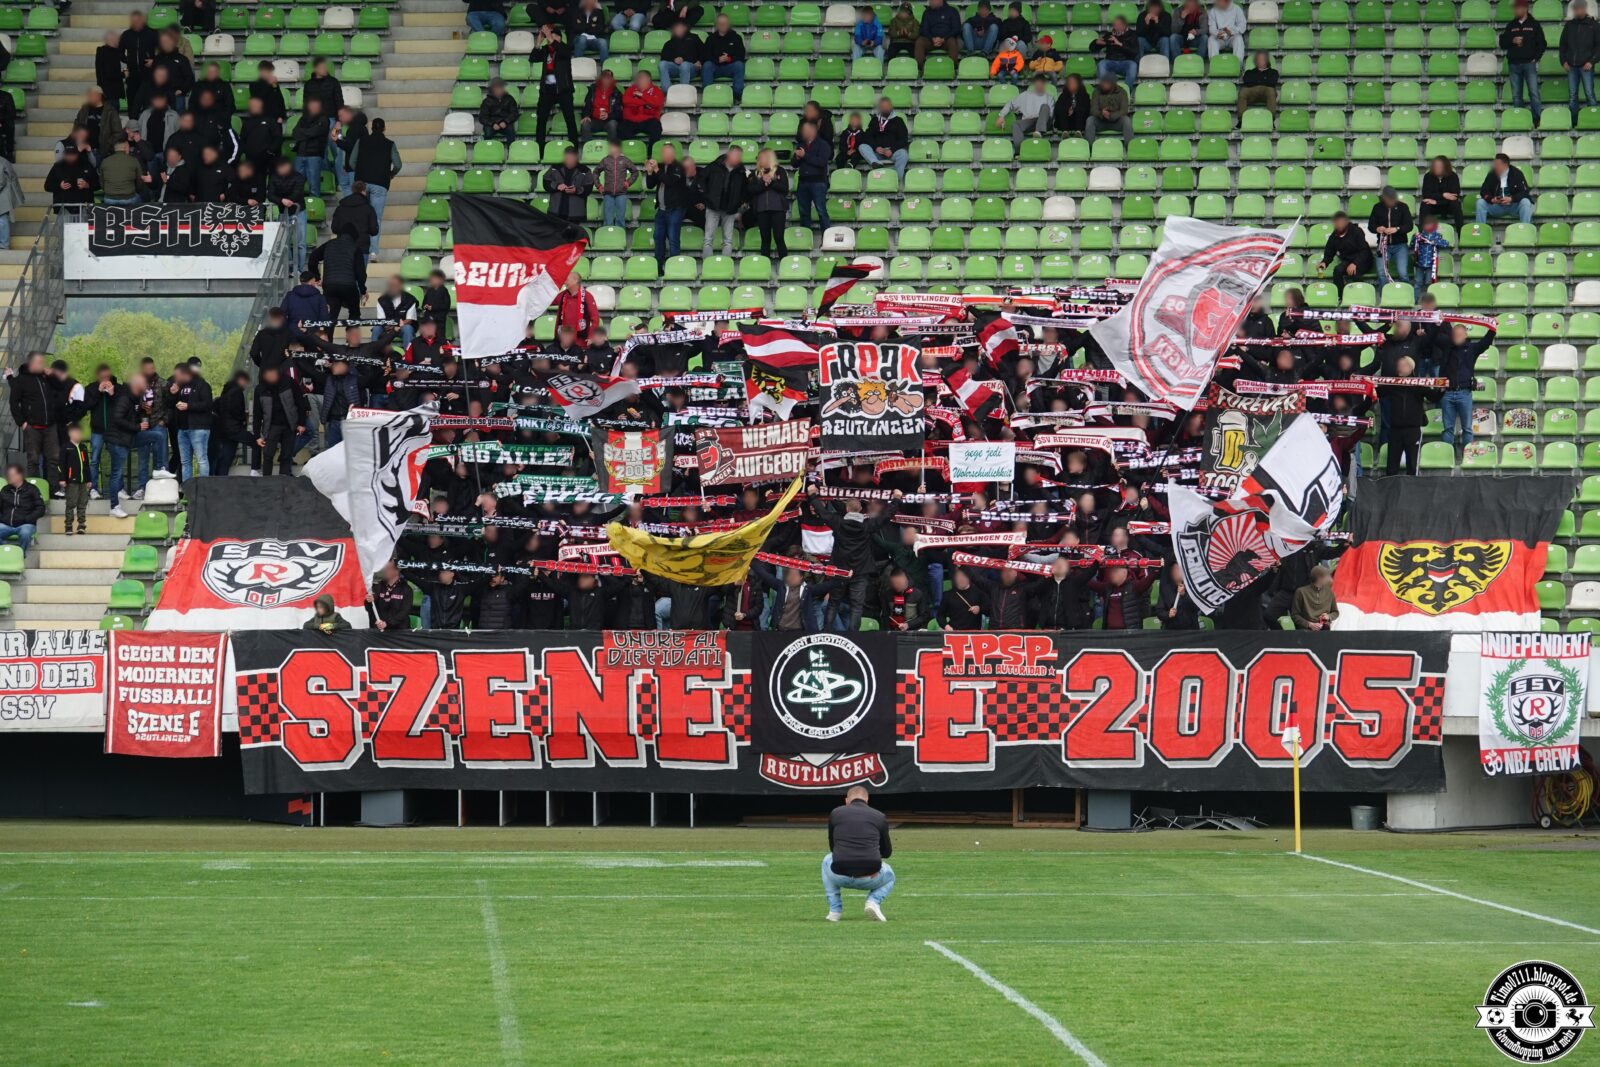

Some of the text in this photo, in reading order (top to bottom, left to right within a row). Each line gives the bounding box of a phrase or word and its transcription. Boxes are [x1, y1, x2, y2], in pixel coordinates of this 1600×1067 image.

[92, 204, 202, 248] BS11
[900, 295, 949, 303] REUTLINGEN
[674, 311, 752, 323] KREUZEICHE
[1341, 333, 1379, 343] SZENE
[687, 406, 738, 417] BLOCK
[1217, 392, 1298, 412] FOREVER
[742, 421, 811, 449] NIEMALS
[822, 417, 926, 436] REUTLINGEN
[1036, 436, 1051, 445] SSV
[1052, 436, 1101, 445] REUTLINGEN
[496, 450, 572, 466] ALLEZ
[604, 442, 653, 462] SZENE
[615, 464, 655, 480] 2005
[734, 451, 808, 479] AUFGEBEN
[928, 534, 1014, 544] SSV REUTLINGEN 05
[222, 541, 330, 559] SSV
[248, 563, 289, 583] R
[1004, 560, 1042, 572] SZENE
[249, 591, 278, 605] 05
[32, 630, 105, 657] ALLE
[694, 630, 720, 648] AI
[784, 635, 858, 658] SAINT BROTHERS
[1482, 631, 1592, 659] INDEPENDENT
[118, 645, 215, 663] GEGEN DEN
[607, 648, 723, 667] DIFFIDATI
[944, 633, 1053, 667] TPSP
[40, 661, 96, 689] DER
[118, 666, 215, 684] MODERNEN
[950, 666, 964, 675] NO
[980, 664, 993, 675] LA
[996, 664, 1047, 676] AUTORIDAD
[1514, 678, 1564, 694] SSV
[119, 687, 212, 705] FUSSBALL!
[1, 695, 57, 720] SSV
[279, 647, 737, 770] SZENE
[915, 647, 1421, 771] E 2005
[1529, 697, 1546, 717] R
[127, 708, 201, 737] SZENE E
[782, 712, 807, 735] SANKT
[808, 725, 841, 737] GALLEN
[765, 755, 876, 783] REUTLINGEN
[1504, 747, 1572, 775] NBZ CREW
